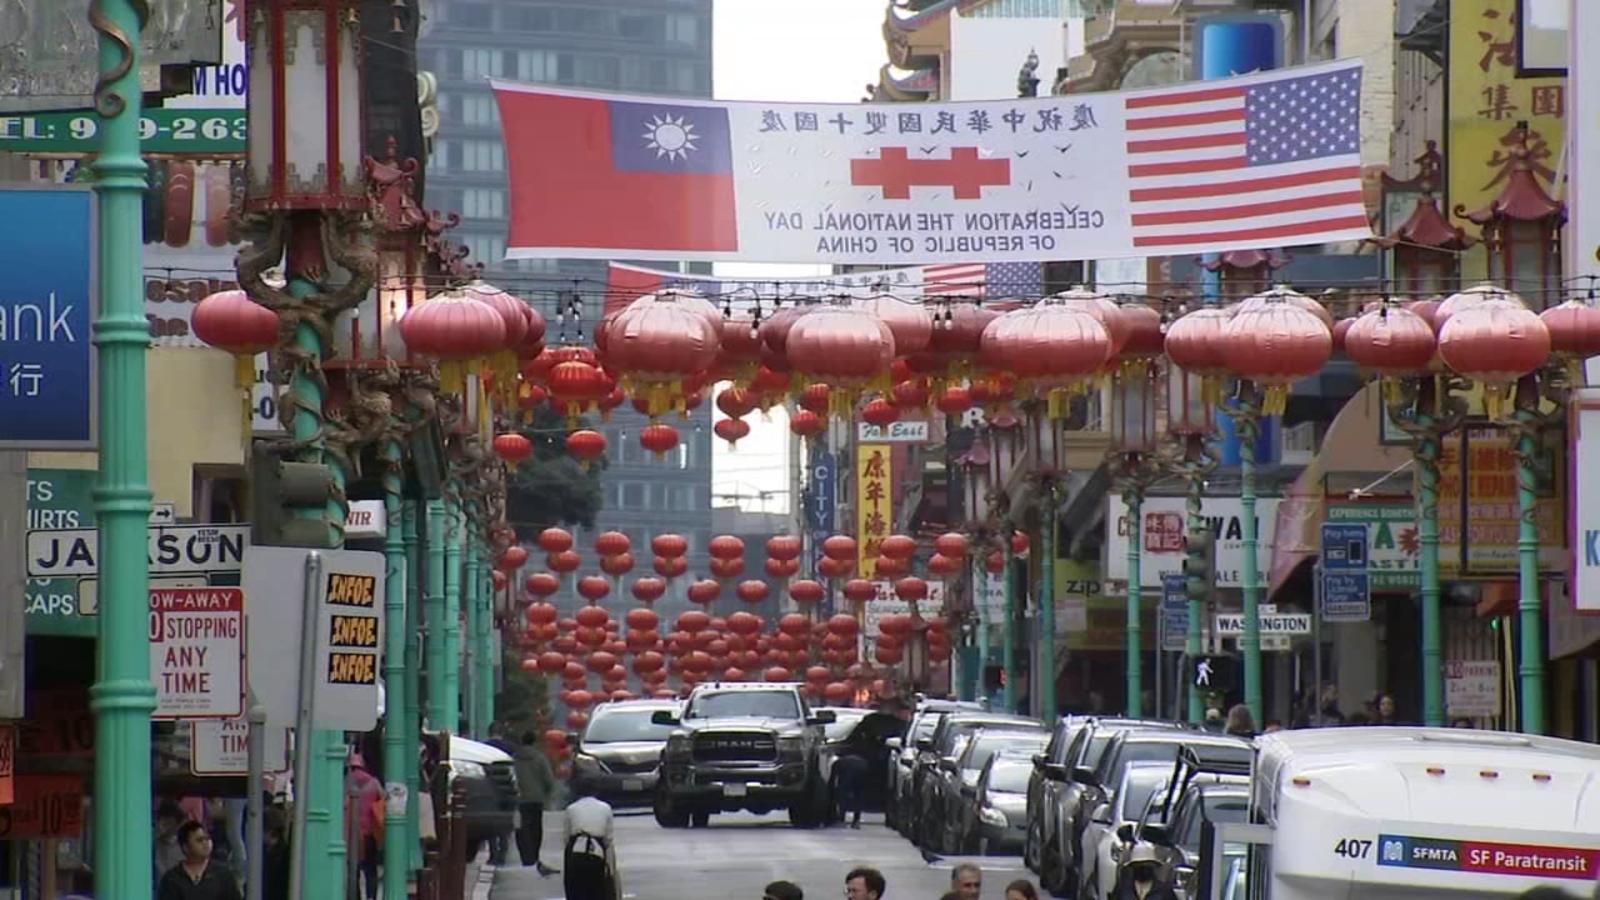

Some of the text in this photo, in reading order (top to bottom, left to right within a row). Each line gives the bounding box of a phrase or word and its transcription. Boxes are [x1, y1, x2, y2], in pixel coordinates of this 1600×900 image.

[69, 117, 247, 140] 99-263
[10, 363, 43, 396] 行
[892, 423, 923, 437] East
[814, 466, 829, 525] CITY
[36, 533, 243, 569] JASON
[1066, 580, 1099, 597] zip
[150, 593, 233, 608] OW-AWAY
[167, 617, 237, 638] STOPPING
[1219, 617, 1307, 631] WASINGTON
[165, 646, 207, 668] ANY
[162, 672, 211, 694] TIME
[221, 735, 248, 753] TIM
[1335, 838, 1372, 858] 407
[1413, 846, 1457, 861] SFMTA
[1470, 849, 1586, 871] SF Paratransit
